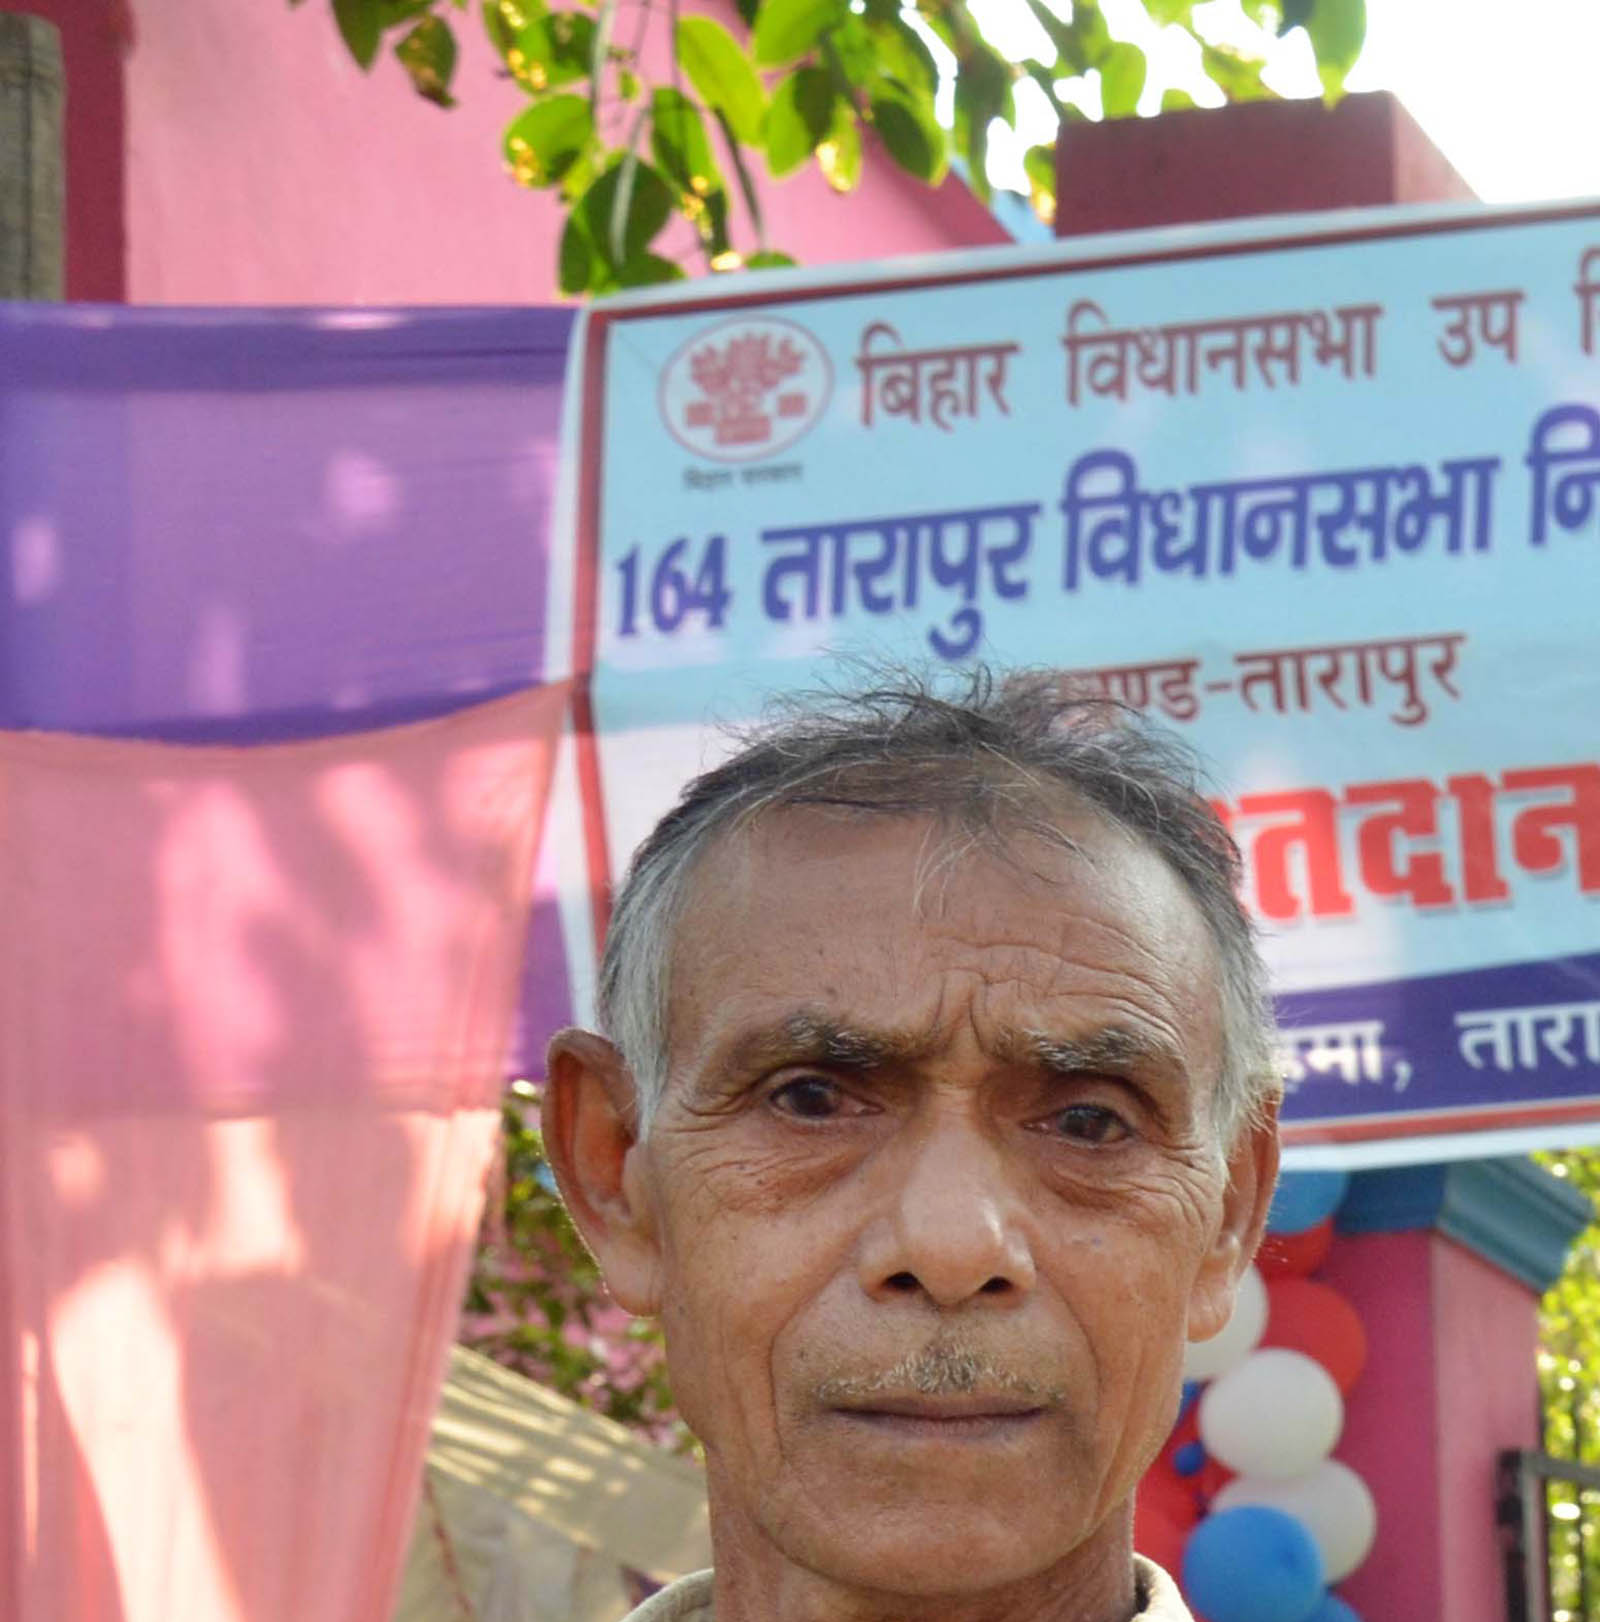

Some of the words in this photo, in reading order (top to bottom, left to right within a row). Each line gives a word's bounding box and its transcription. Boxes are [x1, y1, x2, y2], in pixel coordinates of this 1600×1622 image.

[855, 322, 1020, 431] बिहार
[1062, 299, 1384, 407] विधानसभा
[1430, 288, 1526, 368] उप
[616, 535, 733, 638] 164
[760, 502, 1041, 661] तारापुर
[1060, 449, 1499, 592] विधानसभा
